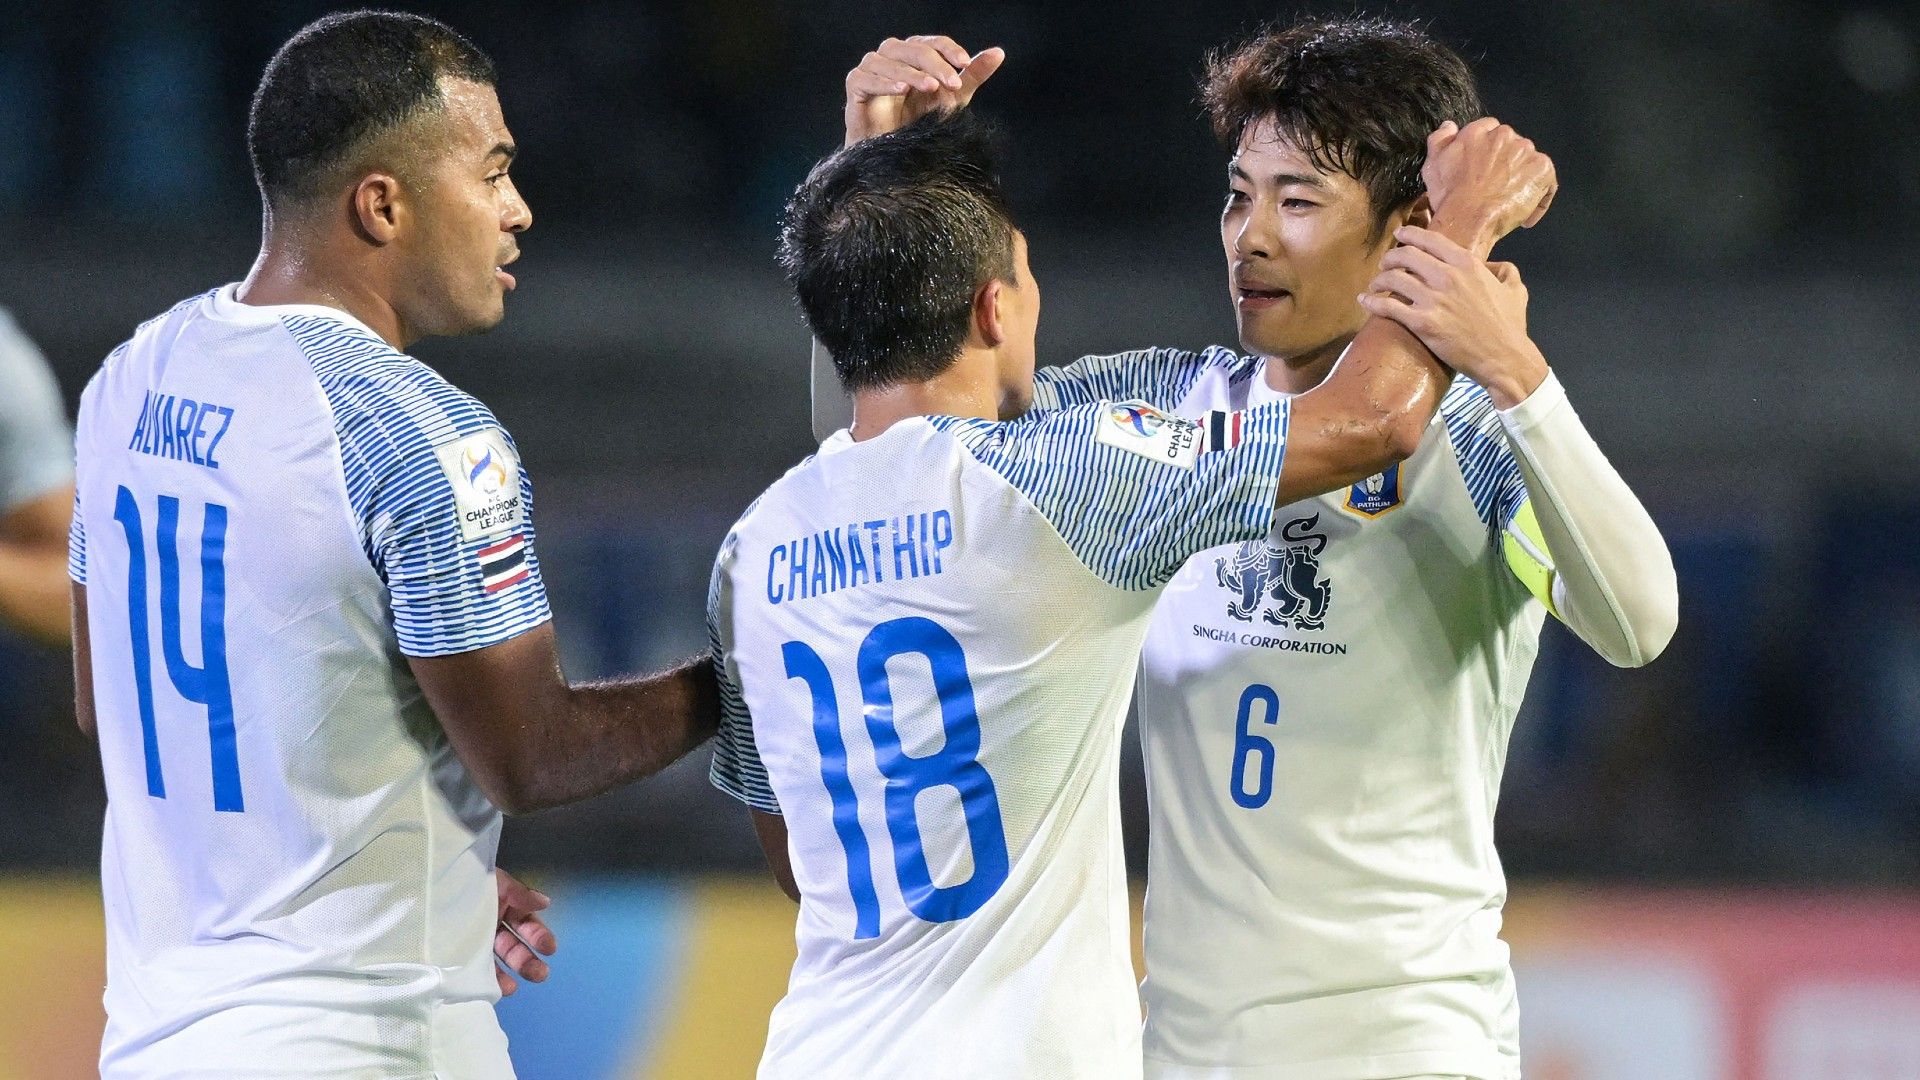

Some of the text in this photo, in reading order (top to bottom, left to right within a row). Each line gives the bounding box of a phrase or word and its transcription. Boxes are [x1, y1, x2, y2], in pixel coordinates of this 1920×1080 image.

[129, 389, 235, 469] ALVAREZ
[466, 496, 519, 522] CHAMPIONS
[479, 510, 515, 530] LEAGUE
[1357, 501, 1391, 509] PATHUM
[767, 509, 953, 604] CHANATHIP
[113, 484, 245, 813] 14
[1192, 624, 1348, 656] SINGHA CORPORATION
[781, 616, 1010, 940] 18
[1230, 683, 1280, 810] 6
